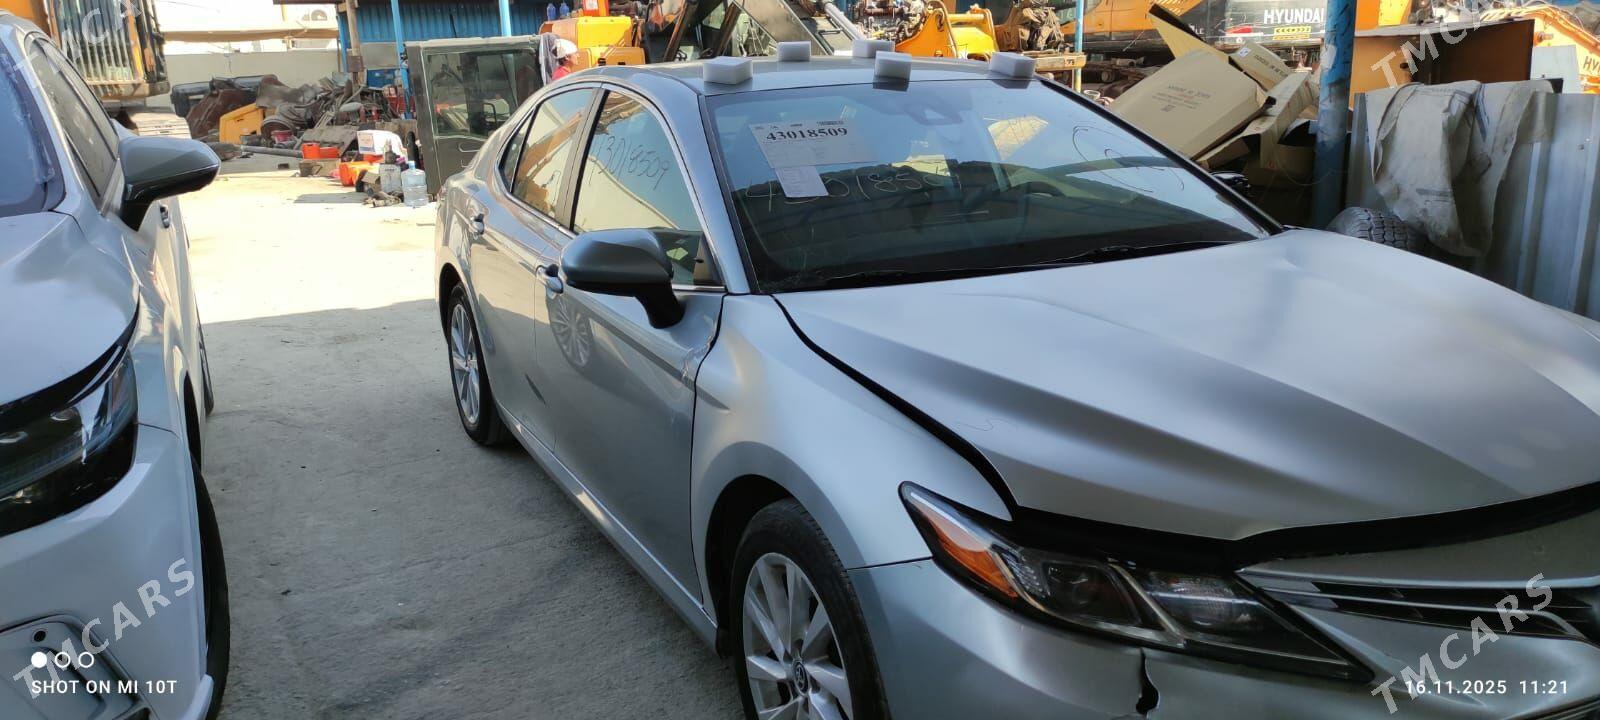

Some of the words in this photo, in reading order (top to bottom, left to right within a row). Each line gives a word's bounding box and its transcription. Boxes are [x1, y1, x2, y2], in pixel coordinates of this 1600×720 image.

[1263, 7, 1324, 25] HYUNDAI
[1582, 55, 1600, 71] HY
[766, 127, 848, 141] 43018509
